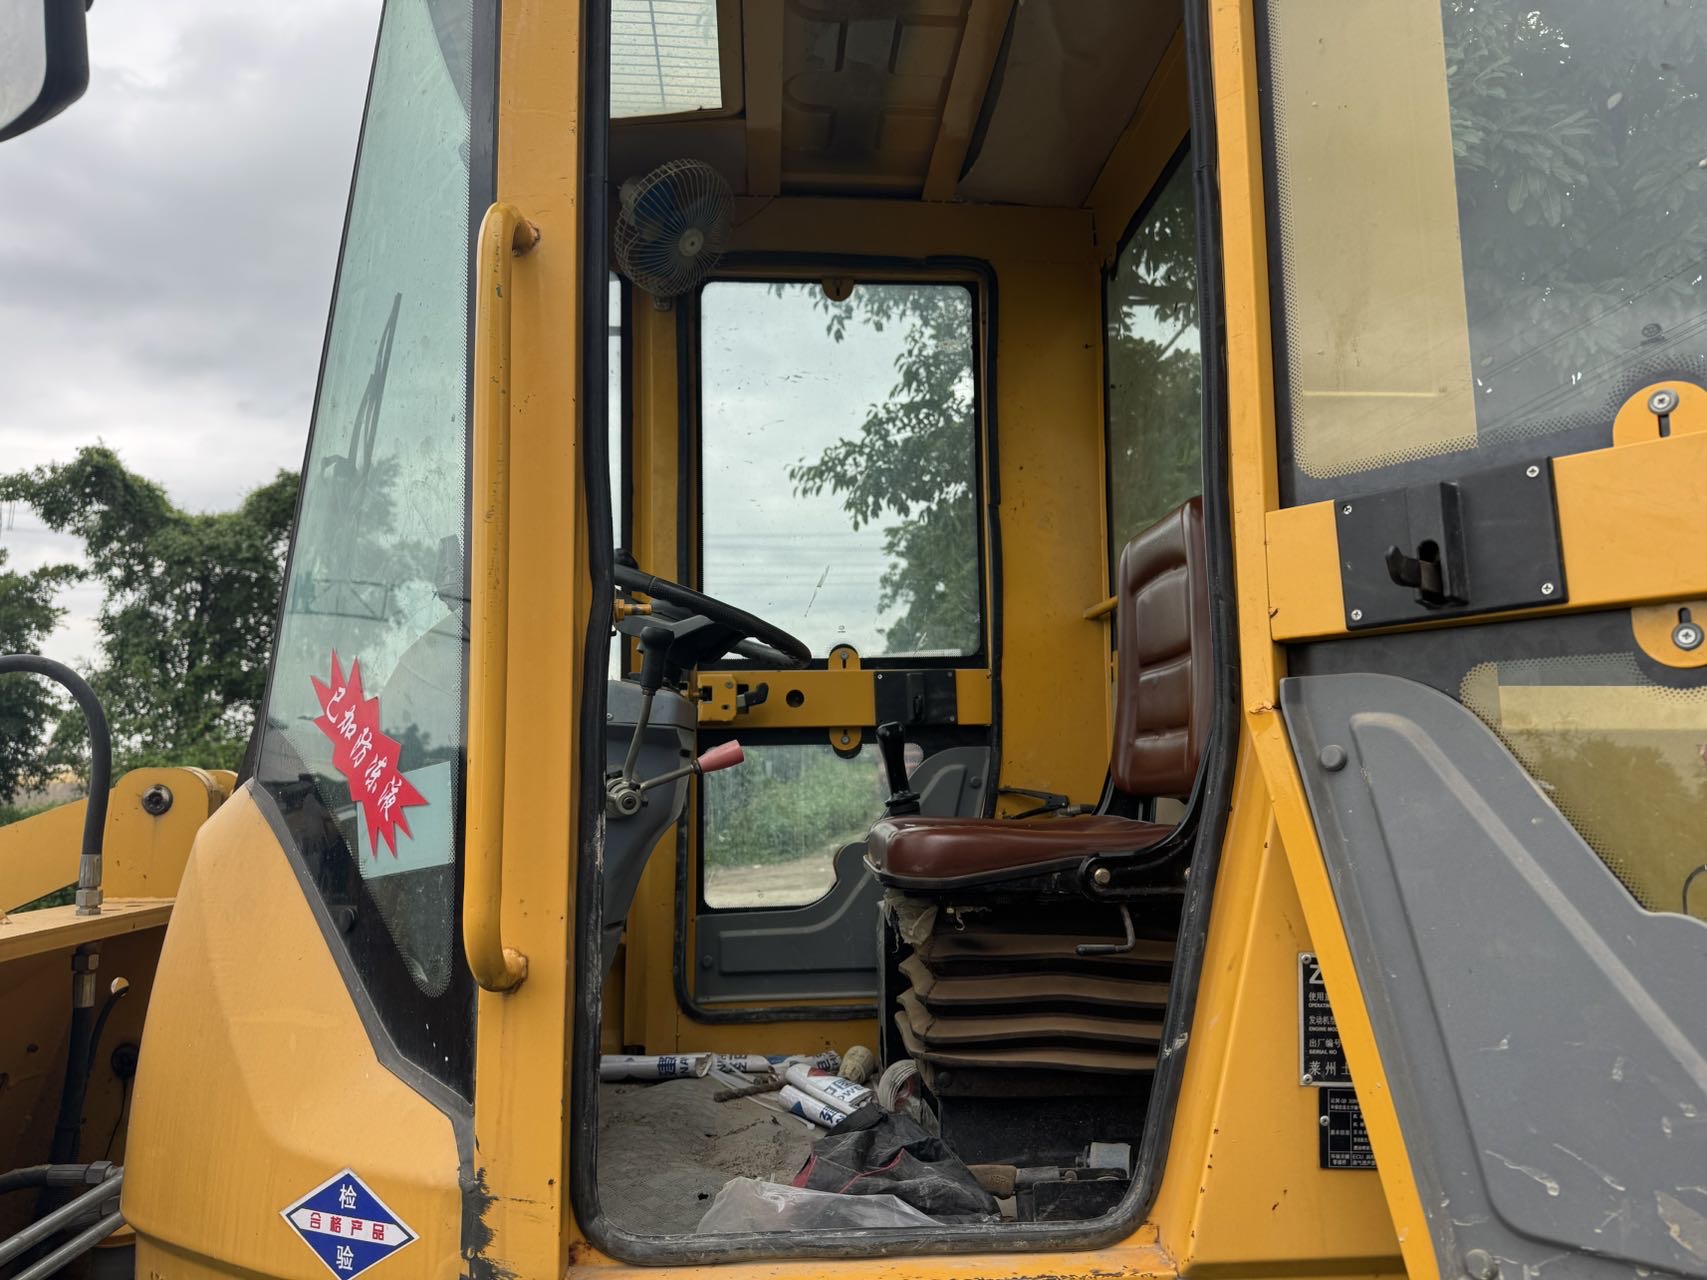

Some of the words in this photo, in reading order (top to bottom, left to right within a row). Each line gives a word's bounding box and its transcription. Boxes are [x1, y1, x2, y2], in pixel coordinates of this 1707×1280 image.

[338, 1183, 357, 1210] 检
[309, 1211, 385, 1242] 合格产品
[335, 1244, 354, 1271] 验
